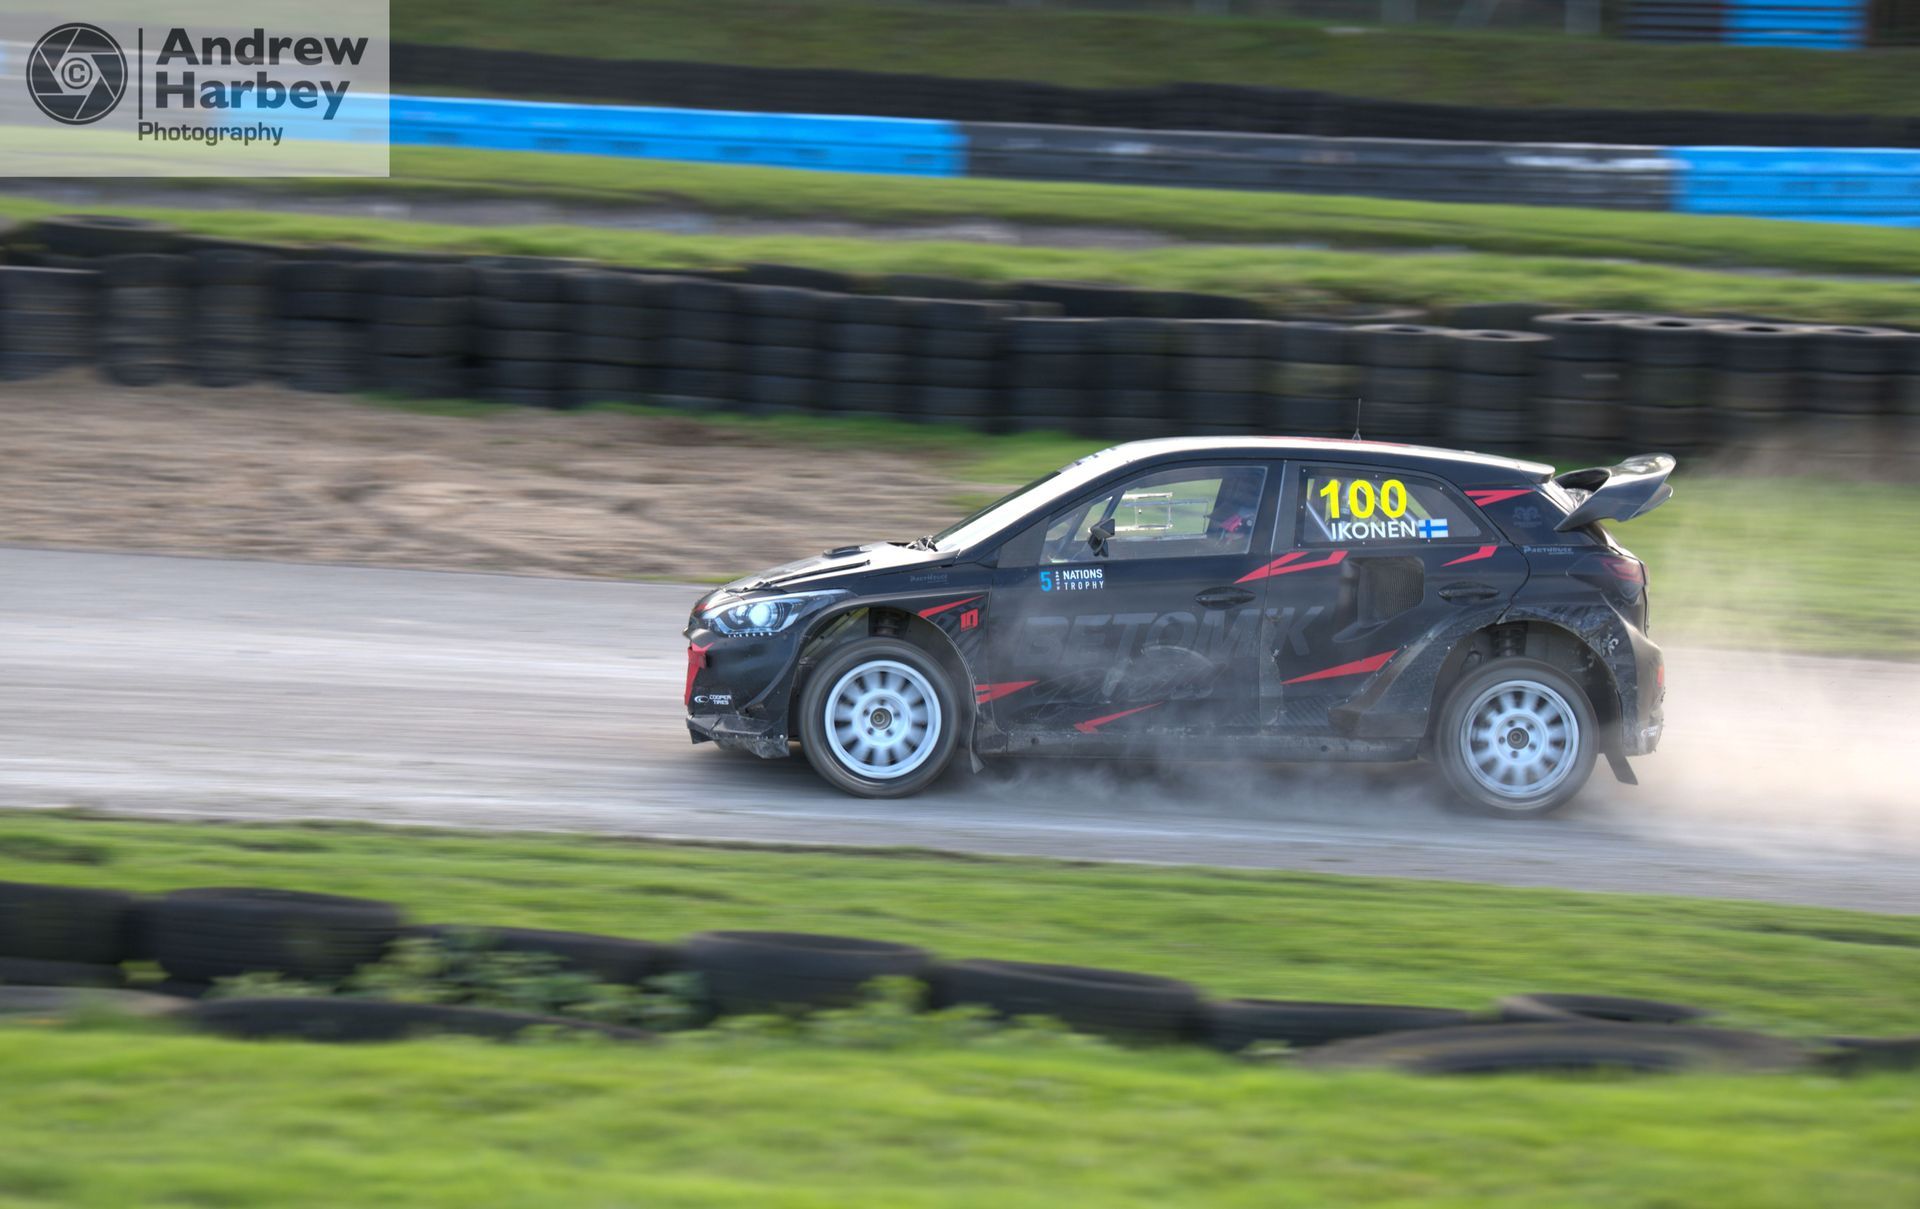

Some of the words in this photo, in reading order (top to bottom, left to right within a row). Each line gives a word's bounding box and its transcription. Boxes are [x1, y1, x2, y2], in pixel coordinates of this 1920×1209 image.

[1320, 479, 1407, 519] 100
[1331, 520, 1416, 540] IKONEN
[1040, 571, 1052, 591] 5
[1062, 569, 1103, 580] NATIONS
[1064, 580, 1104, 590] TROPHY
